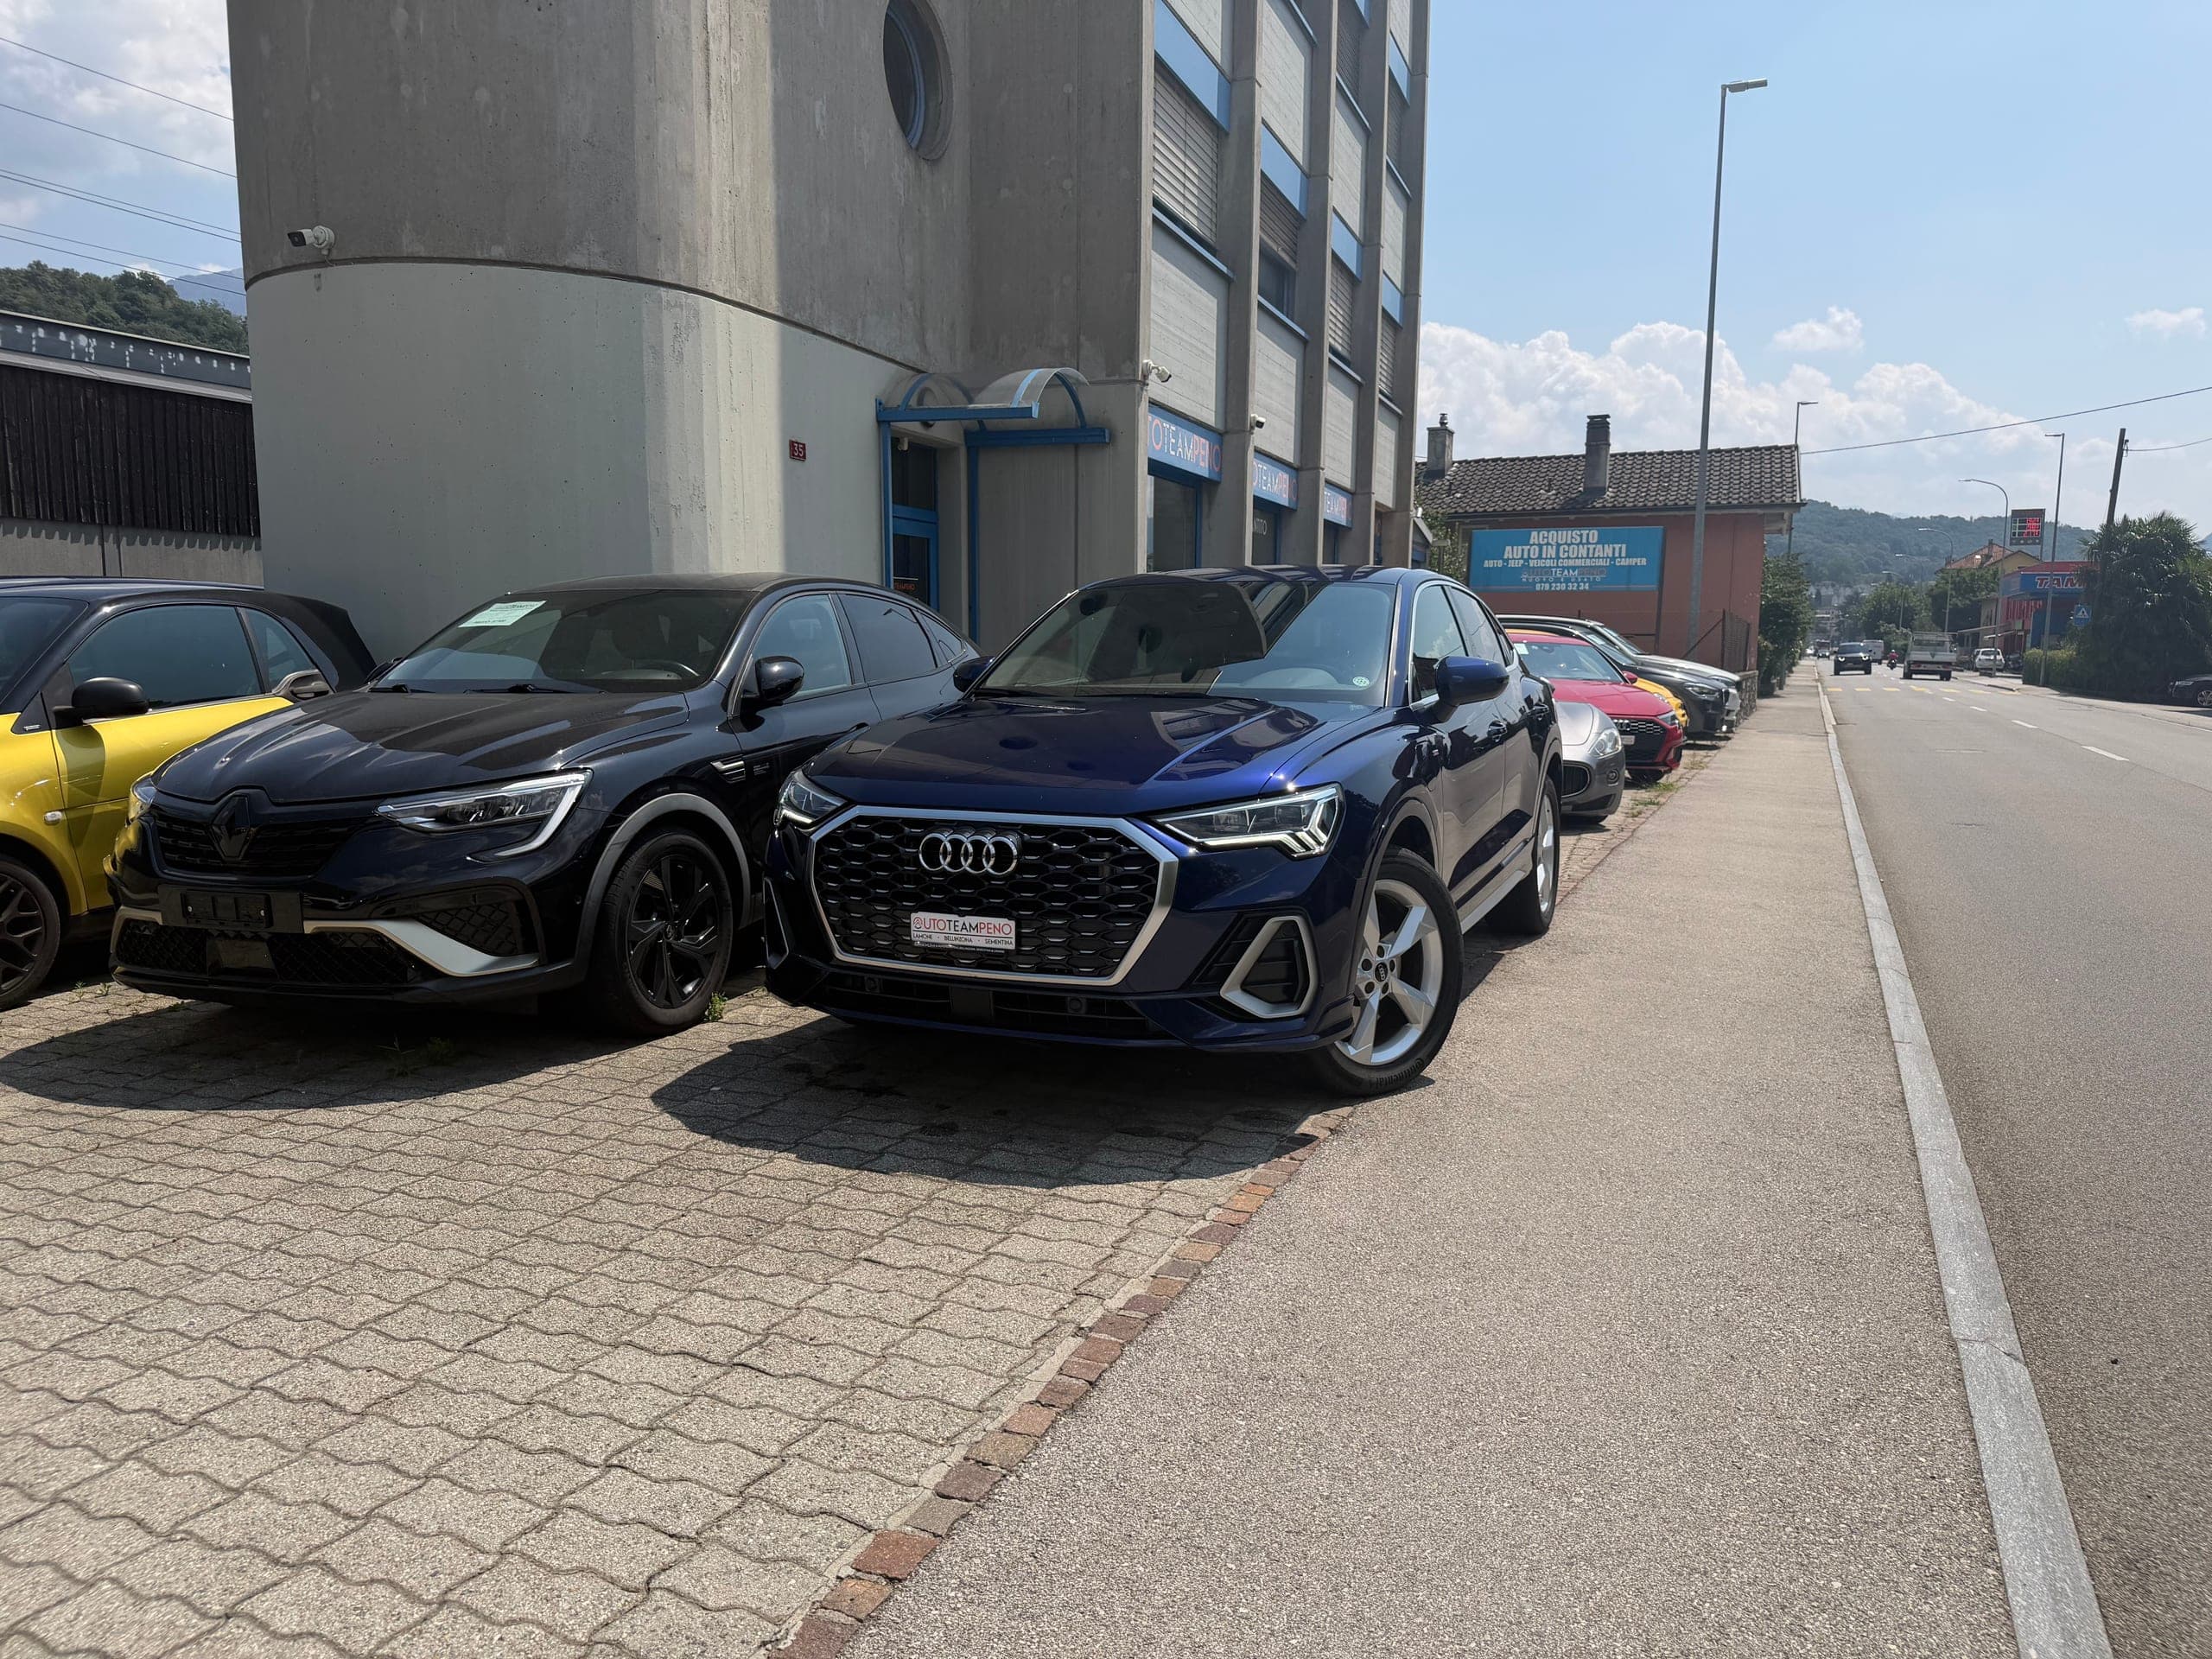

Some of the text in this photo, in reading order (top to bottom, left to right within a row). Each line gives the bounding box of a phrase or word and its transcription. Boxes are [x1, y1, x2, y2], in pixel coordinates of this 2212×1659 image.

[793, 442, 804, 457] 35
[1529, 530, 1598, 544] ACQUISTO
[1503, 544, 1627, 559] AUTO IN CONTANTI
[1558, 558, 1610, 567] COMMERCIALI
[1615, 557, 1647, 566] CAMPER
